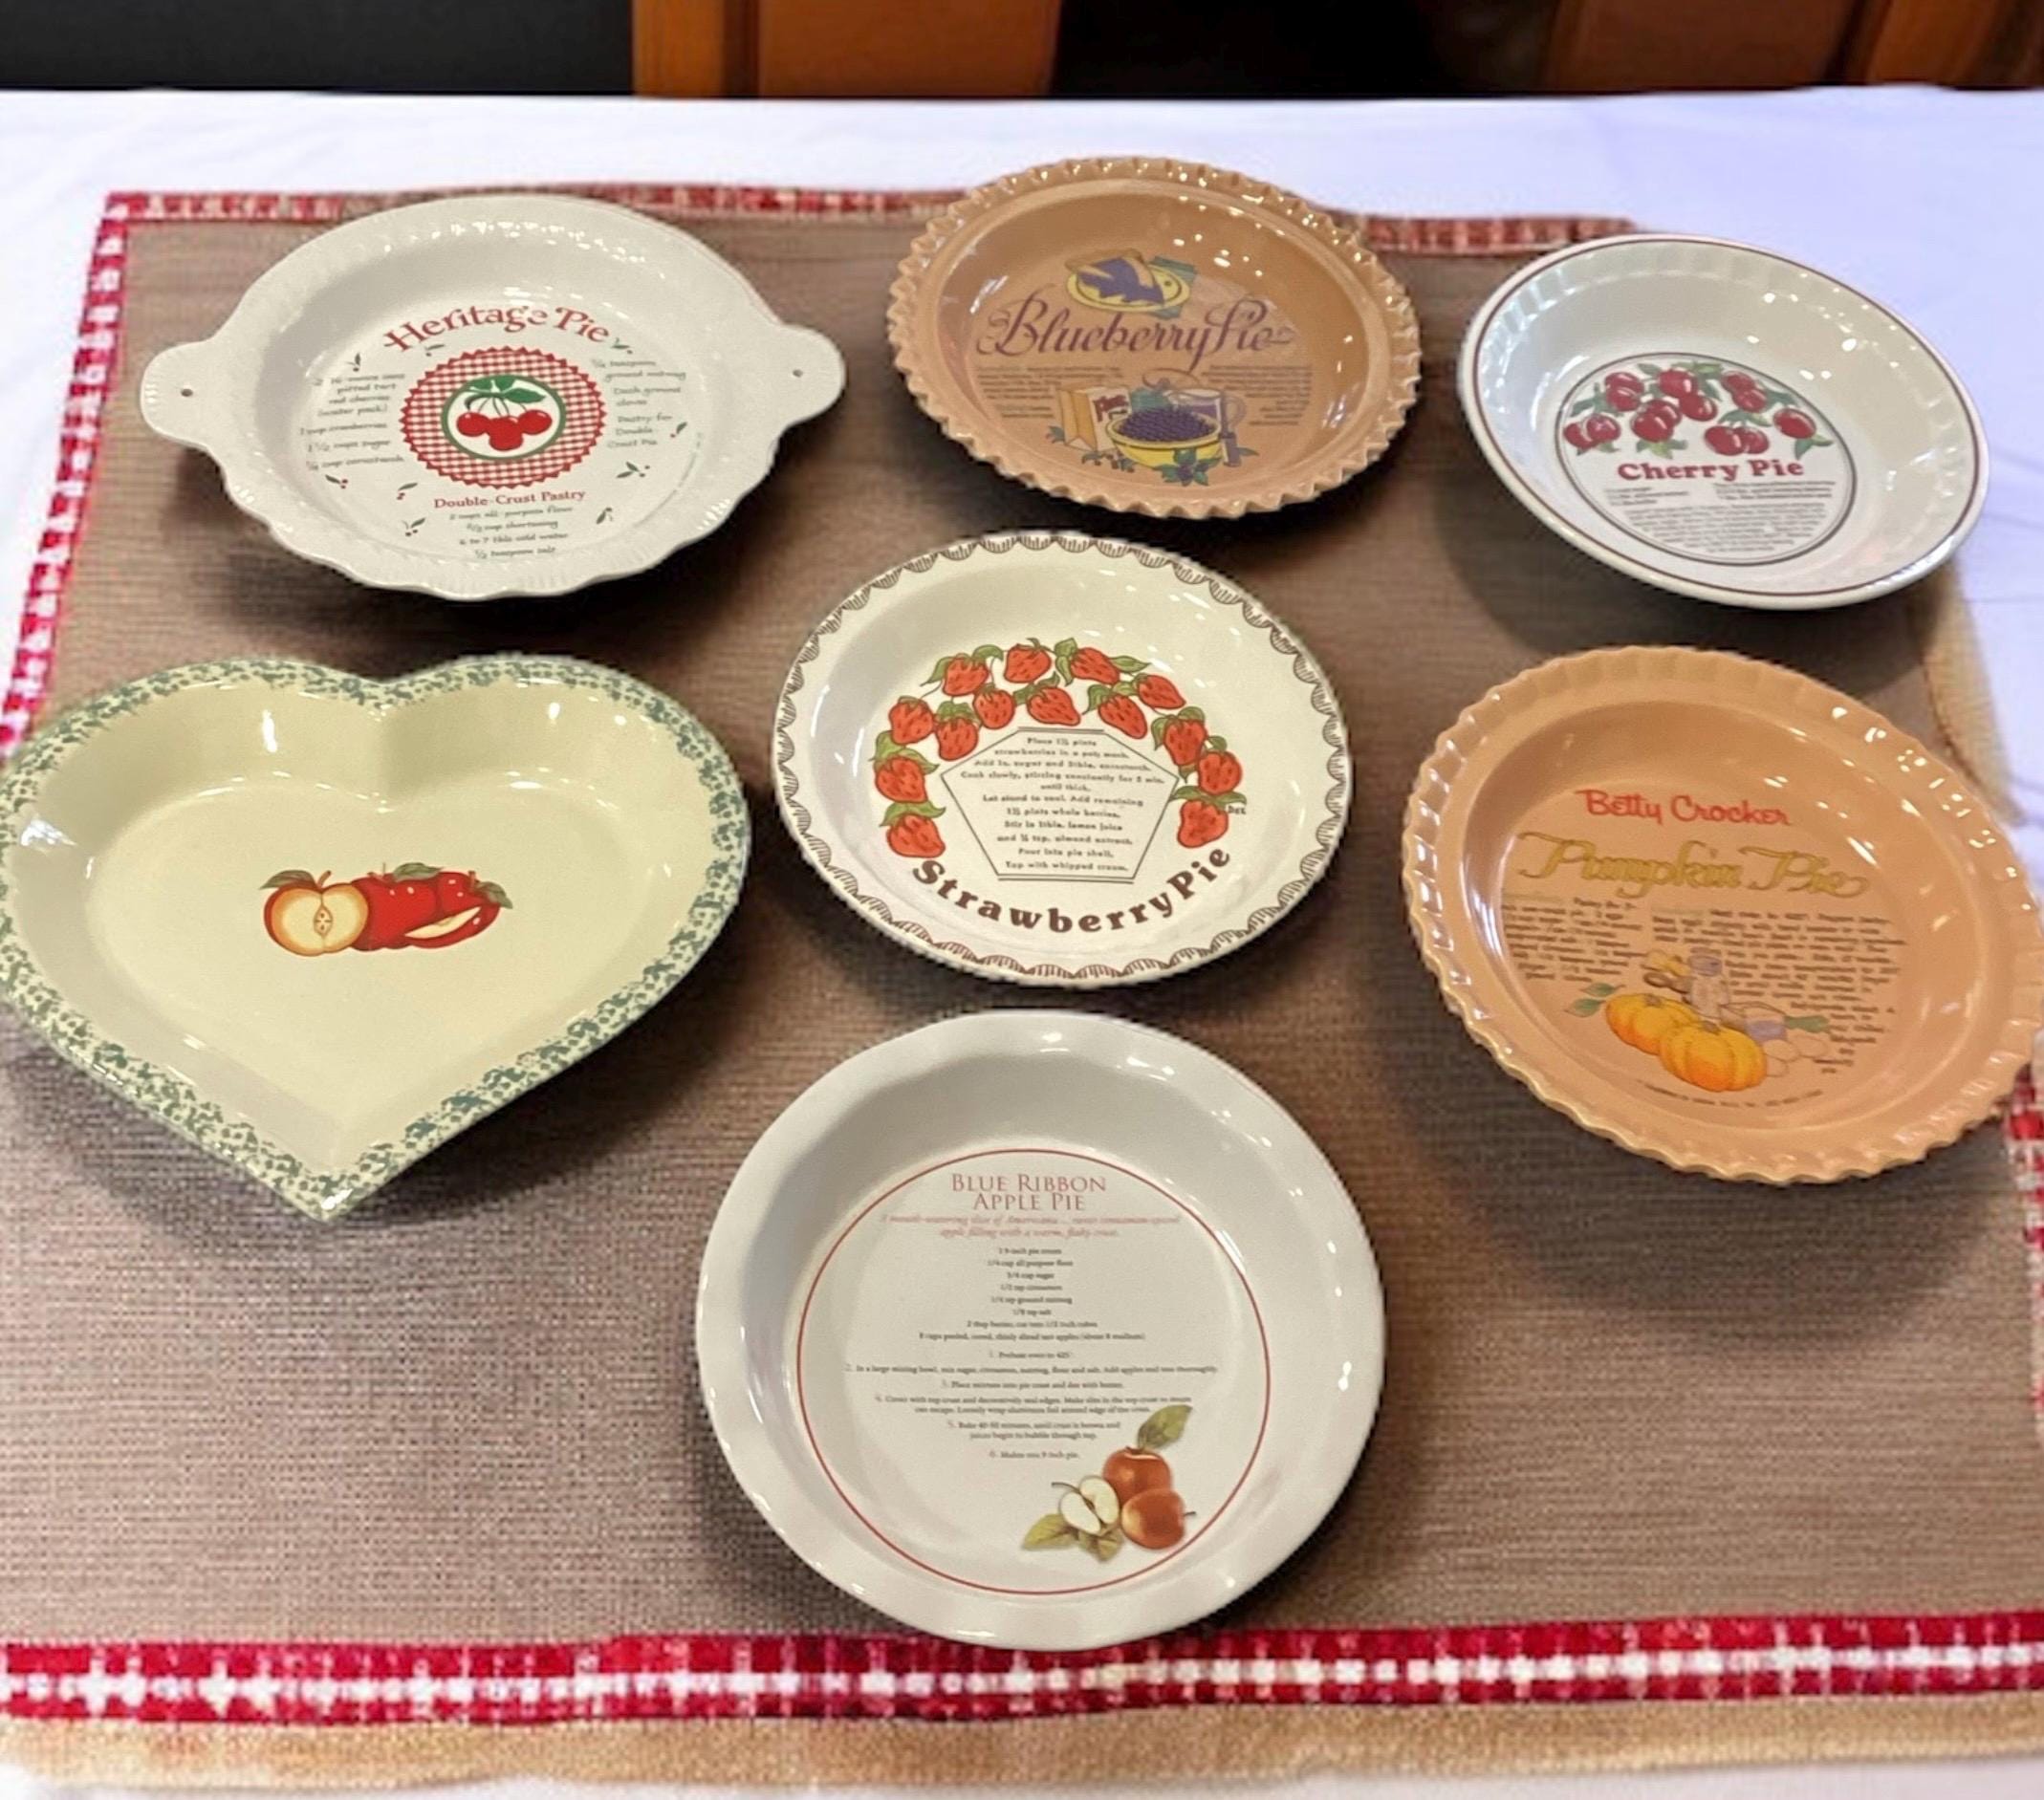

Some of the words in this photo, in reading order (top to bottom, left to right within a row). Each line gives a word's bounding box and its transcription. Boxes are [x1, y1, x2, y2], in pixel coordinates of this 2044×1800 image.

[383, 305, 548, 352] Heritage
[553, 306, 609, 342] Pie
[975, 288, 1207, 376] Blueberry
[1205, 295, 1294, 354] Pie
[1618, 461, 1739, 482] Cherry
[1748, 458, 1804, 477] Pie
[541, 490, 586, 502] Pastry
[1576, 789, 1663, 825] Betty
[1670, 794, 1792, 825] Crocker
[1517, 831, 1742, 899] Pumpkin
[1738, 846, 1870, 898] Pie
[912, 859, 1172, 933] Strawberry
[1166, 847, 1230, 900] Pie
[951, 1173, 1008, 1192] BLUE
[1017, 1173, 1106, 1193] RIBBON
[972, 1192, 1040, 1210] APPLE
[1051, 1193, 1085, 1210] PIE
